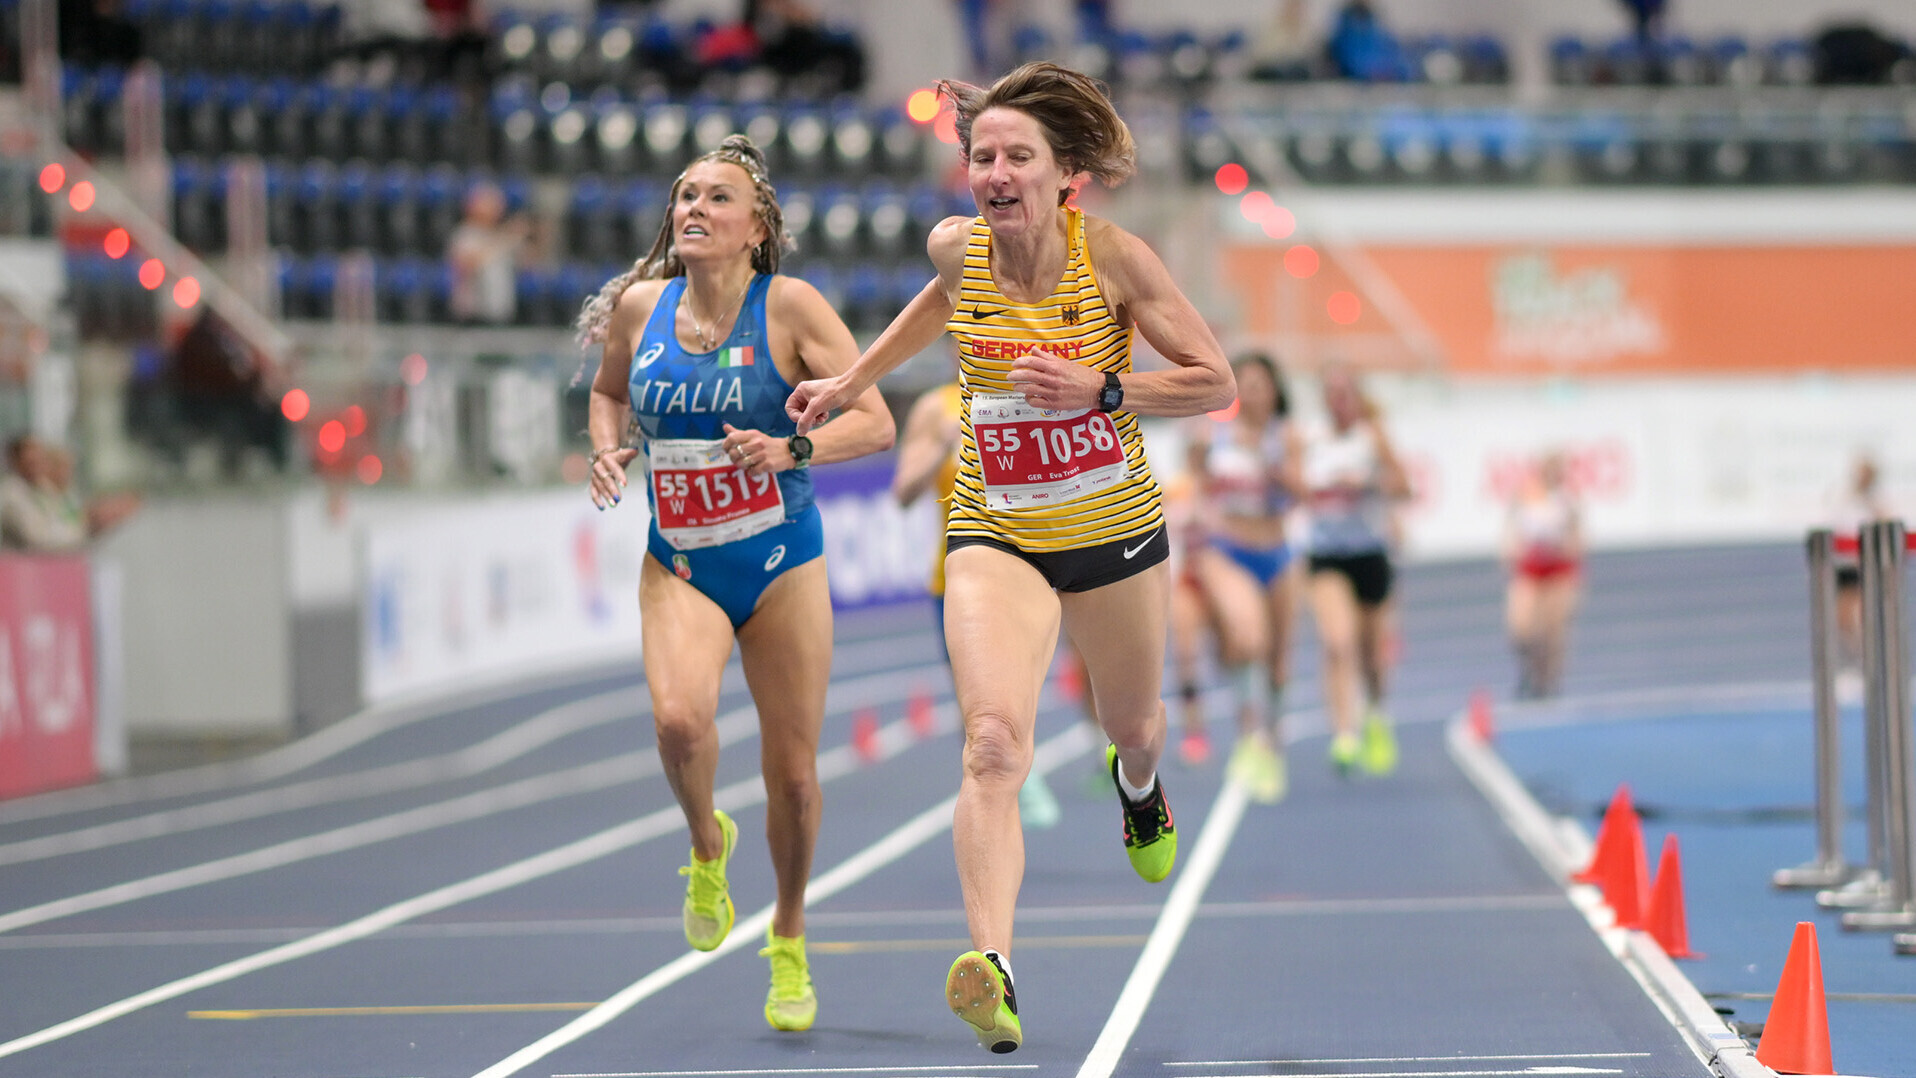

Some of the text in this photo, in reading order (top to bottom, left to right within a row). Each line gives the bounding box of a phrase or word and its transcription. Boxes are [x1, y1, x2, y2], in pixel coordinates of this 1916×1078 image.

[640, 377, 743, 413] ITALIA
[983, 416, 1113, 465] 55 1058
[997, 455, 1014, 471] W
[660, 469, 769, 511] 55 1519
[669, 499, 685, 515] W
